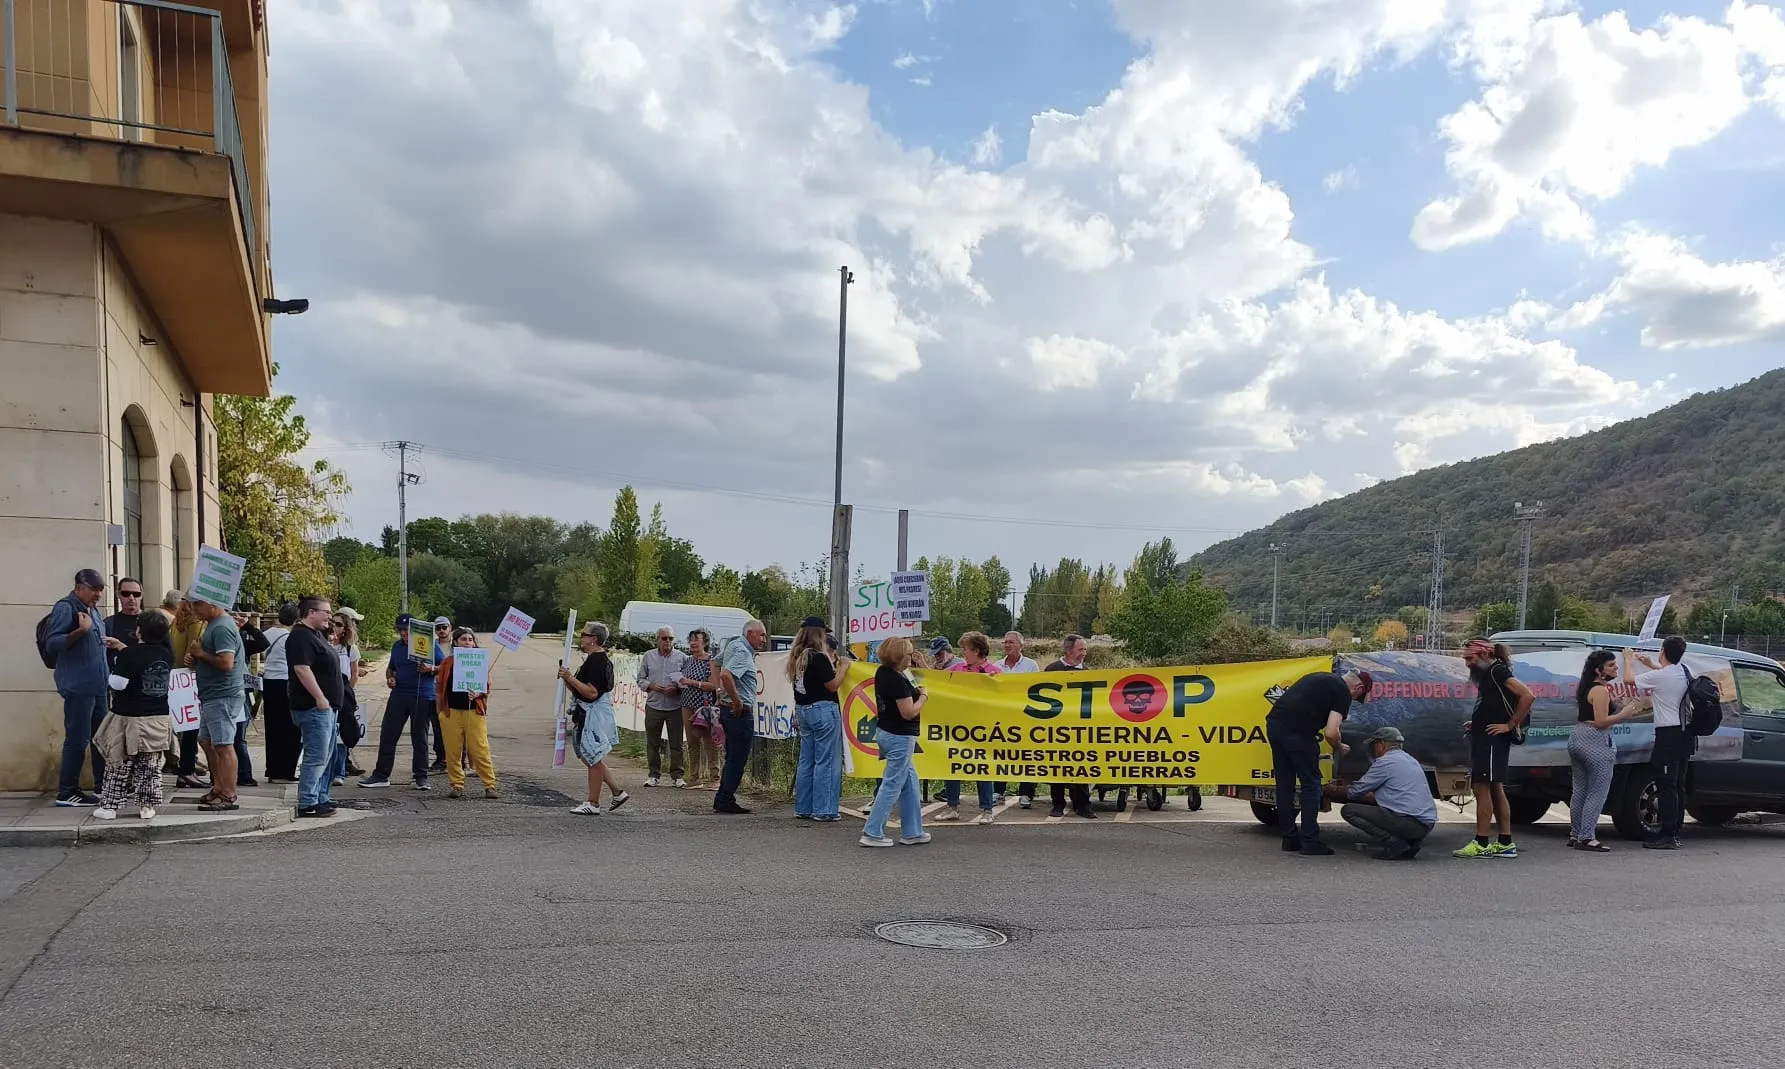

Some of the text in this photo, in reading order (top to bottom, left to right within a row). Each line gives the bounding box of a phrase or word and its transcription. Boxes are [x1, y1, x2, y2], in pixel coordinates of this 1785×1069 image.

[854, 583, 894, 608] STO
[850, 611, 915, 633] BIOGA
[927, 722, 1022, 743] BIOGÁS
[1029, 726, 1173, 744] CISTIERNA
[1198, 726, 1269, 744] VIDA
[947, 747, 1201, 763] POR NUESTROS PUEBLOS
[950, 762, 1197, 779] POR NUESTRAS TIERRAS
